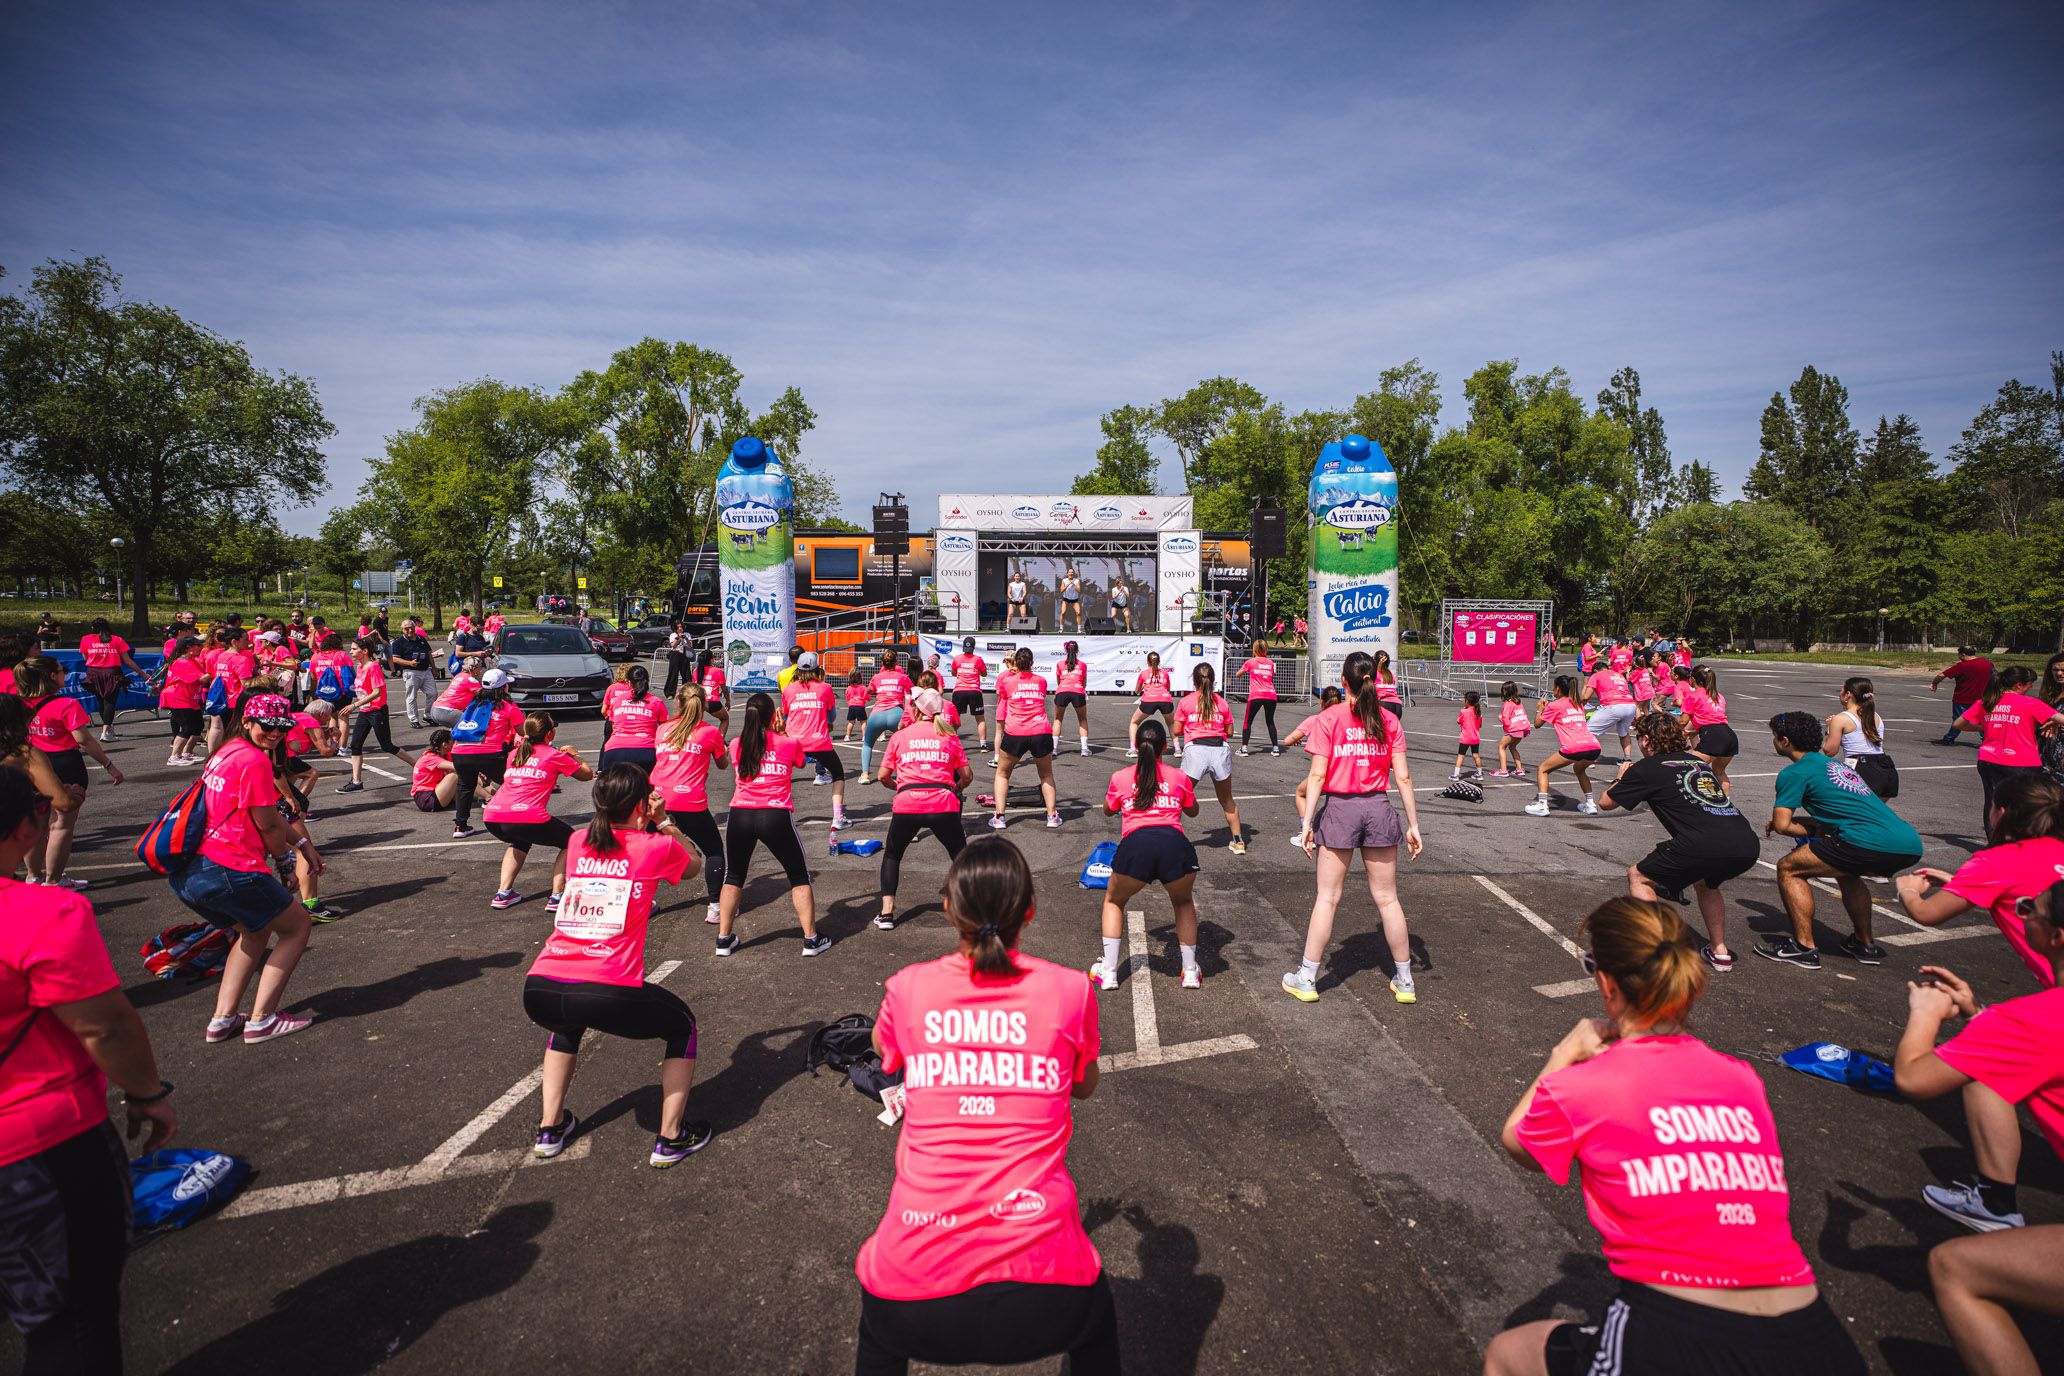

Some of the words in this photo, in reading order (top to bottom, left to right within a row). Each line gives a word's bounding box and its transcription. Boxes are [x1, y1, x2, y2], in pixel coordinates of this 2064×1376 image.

[724, 512, 775, 523] ASTURIANA
[1330, 512, 1386, 522] ASTURIANA
[727, 579, 755, 597] Leche
[1328, 582, 1344, 591] Leche
[725, 592, 782, 616] semi
[1329, 591, 1382, 618] Calcio
[726, 616, 783, 630] desnatada
[1352, 616, 1381, 627] natural
[909, 739, 940, 749] SOMOS
[575, 856, 629, 877] SOMOS
[580, 906, 604, 916] 016
[924, 1009, 1027, 1045] SOMOS
[958, 1096, 996, 1115] 2026
[1648, 1105, 1762, 1145] SOMOS
[1619, 1151, 1788, 1198] IMPARABLE
[1715, 1202, 1756, 1226] 2026
